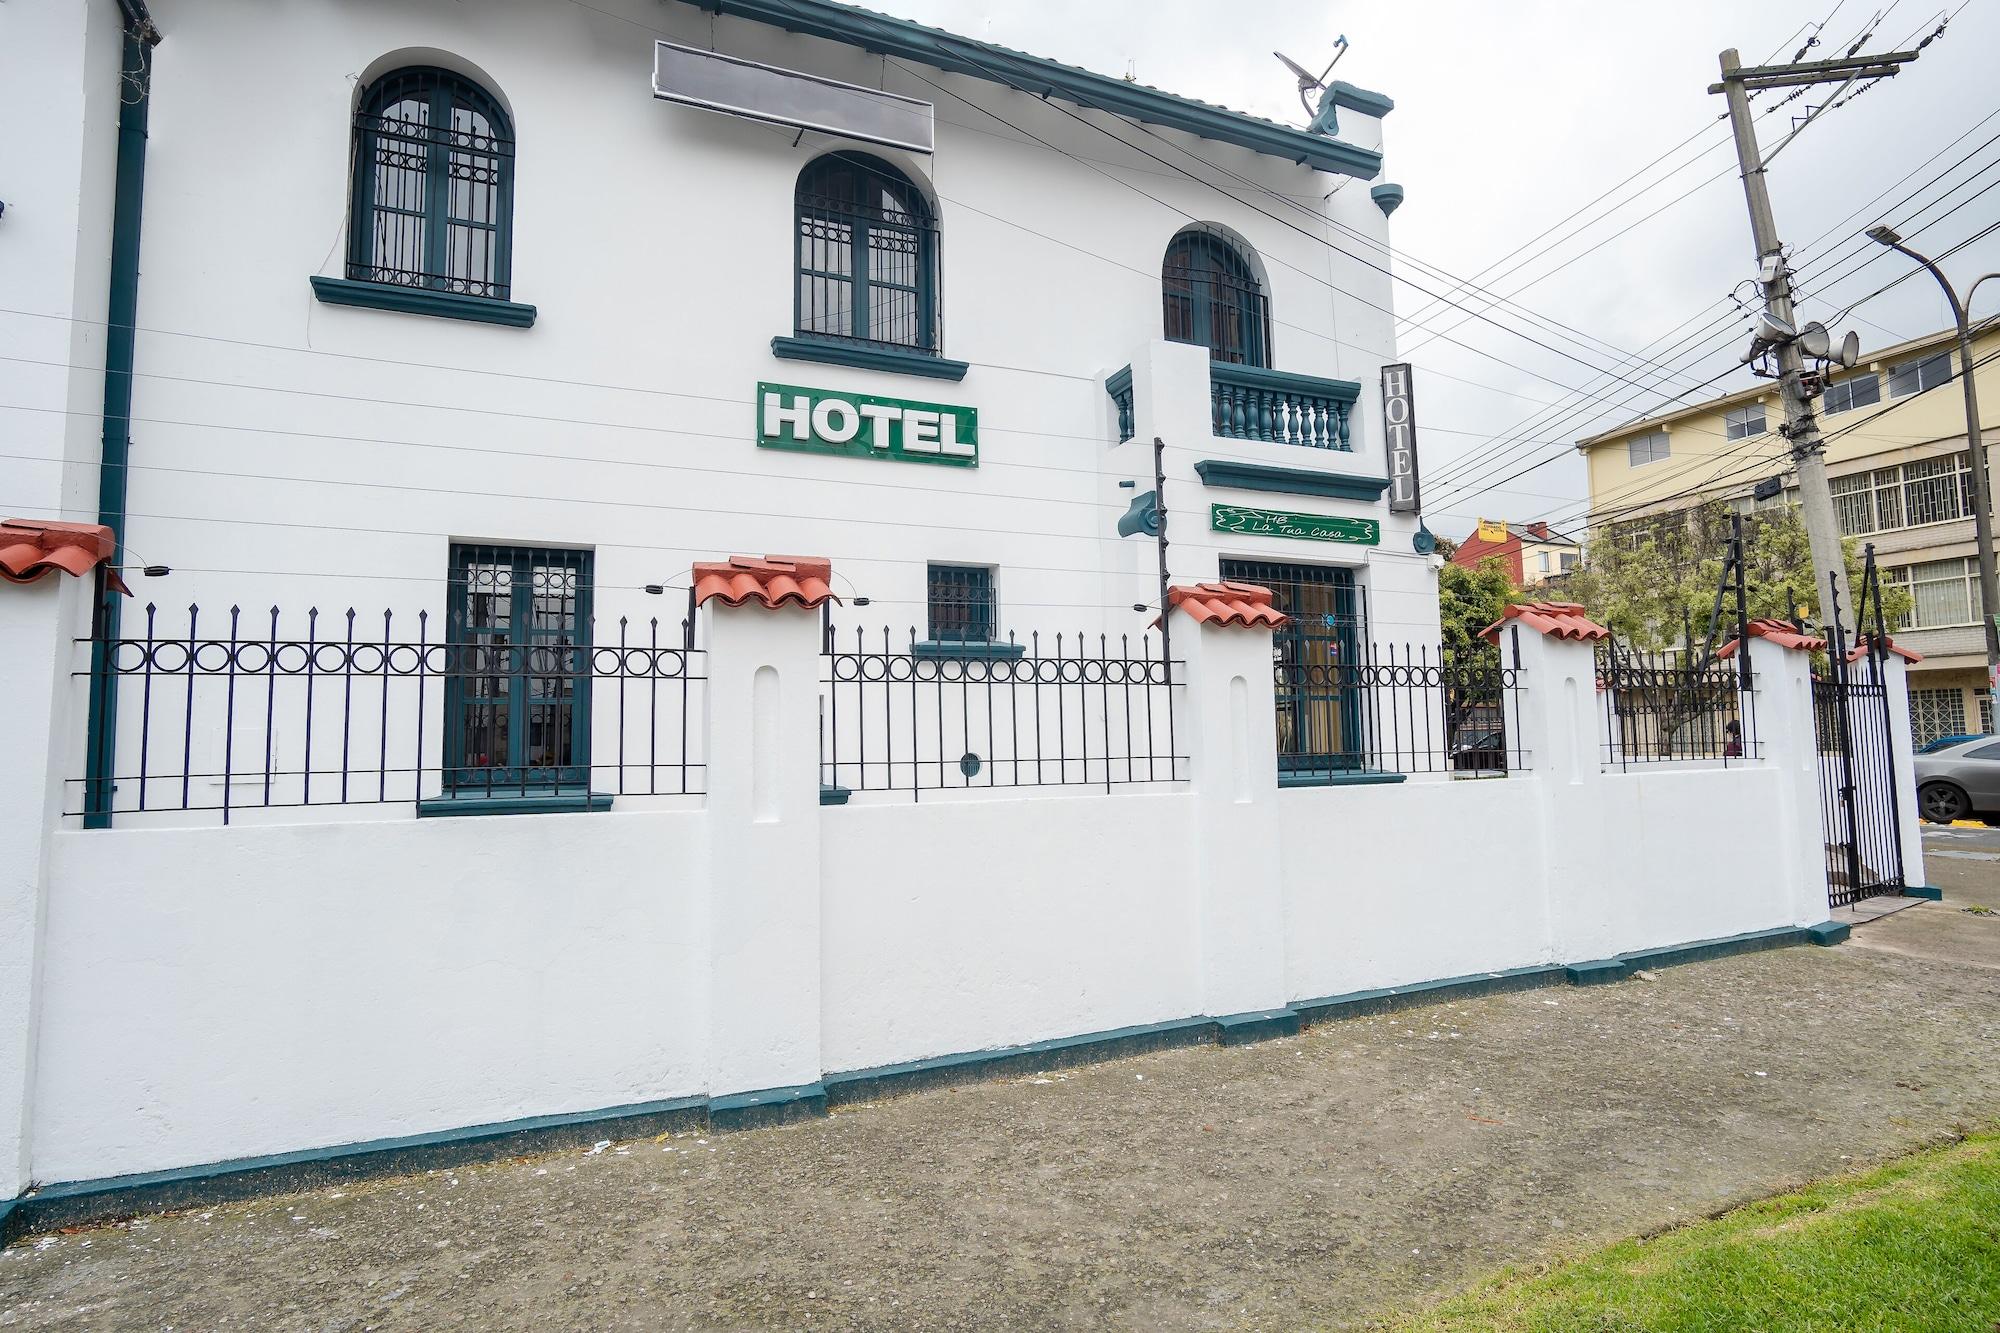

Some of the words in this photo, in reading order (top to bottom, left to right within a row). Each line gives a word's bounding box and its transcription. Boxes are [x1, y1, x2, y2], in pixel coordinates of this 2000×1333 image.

[764, 392, 976, 457] HOTEL
[1385, 371, 1414, 502] HOTEL
[1252, 521, 1273, 531] La
[1280, 525, 1306, 535] Tua
[1311, 527, 1345, 538] Casa
